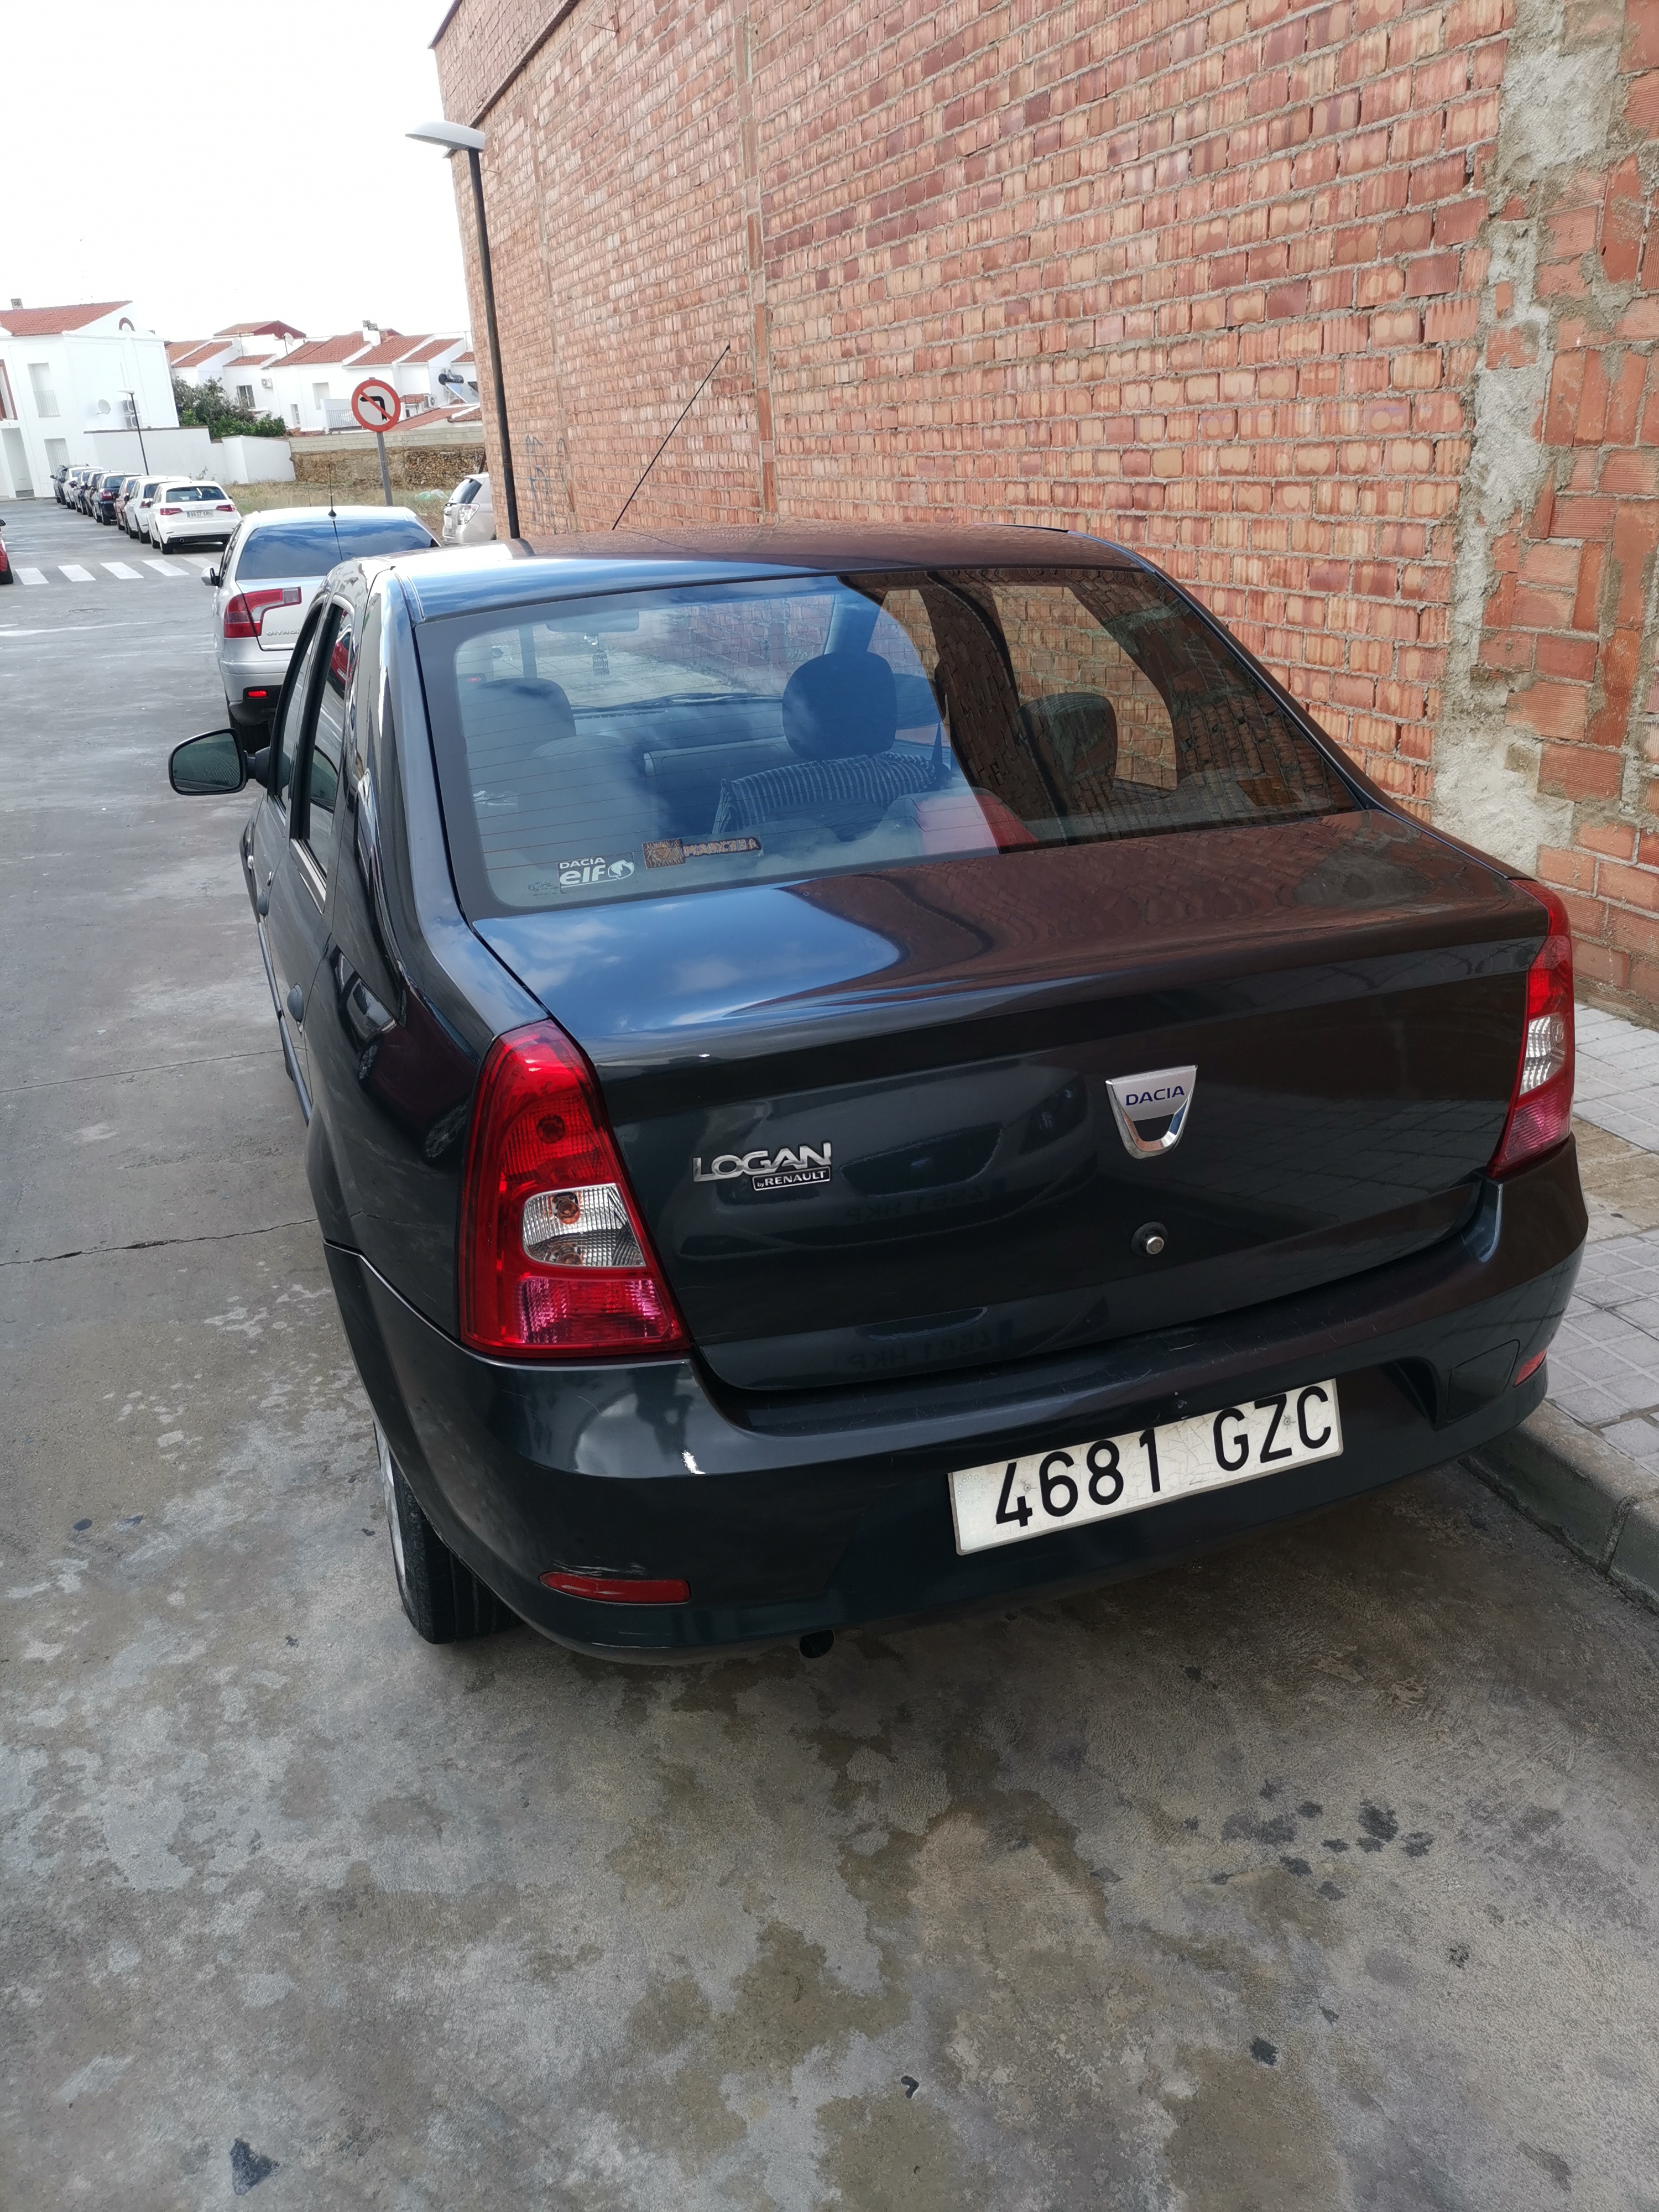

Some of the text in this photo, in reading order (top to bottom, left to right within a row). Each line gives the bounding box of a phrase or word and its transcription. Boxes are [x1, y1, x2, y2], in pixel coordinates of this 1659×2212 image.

[560, 857, 606, 869] DACIA
[560, 864, 606, 885] elf
[1125, 1085, 1185, 1106] DACIA
[692, 1142, 832, 1182] LOGAN
[765, 1170, 826, 1186] RENAULT
[995, 1386, 1331, 1527] 4681 GZC
